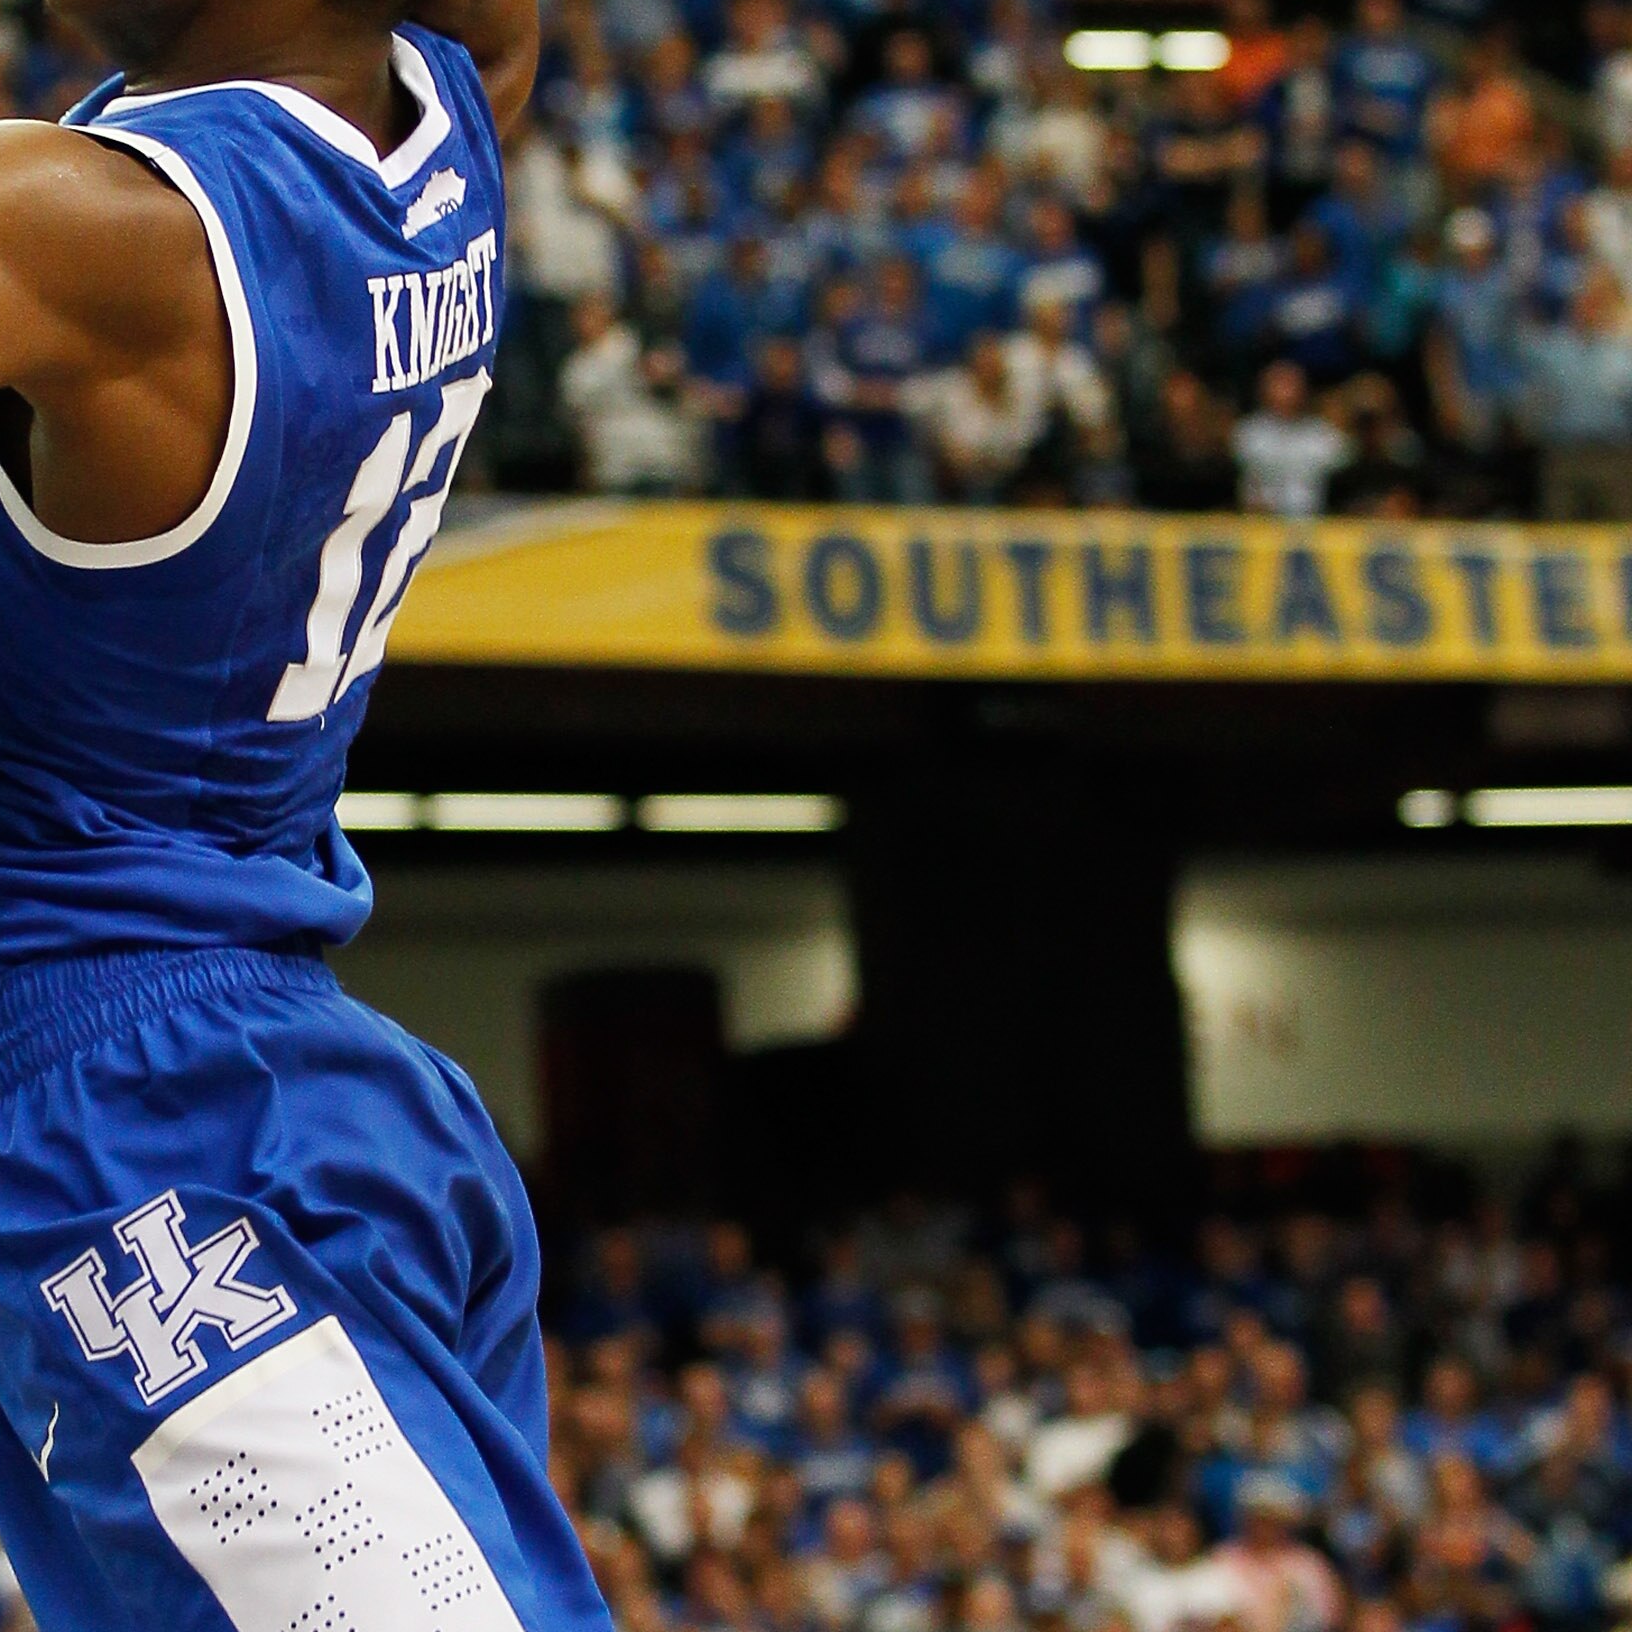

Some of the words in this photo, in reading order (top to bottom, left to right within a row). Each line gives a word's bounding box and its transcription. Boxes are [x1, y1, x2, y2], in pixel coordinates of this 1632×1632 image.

[367, 228, 497, 393] KNIGHT
[267, 366, 493, 723] 12
[705, 528, 1632, 648] SOUTHEASTE
